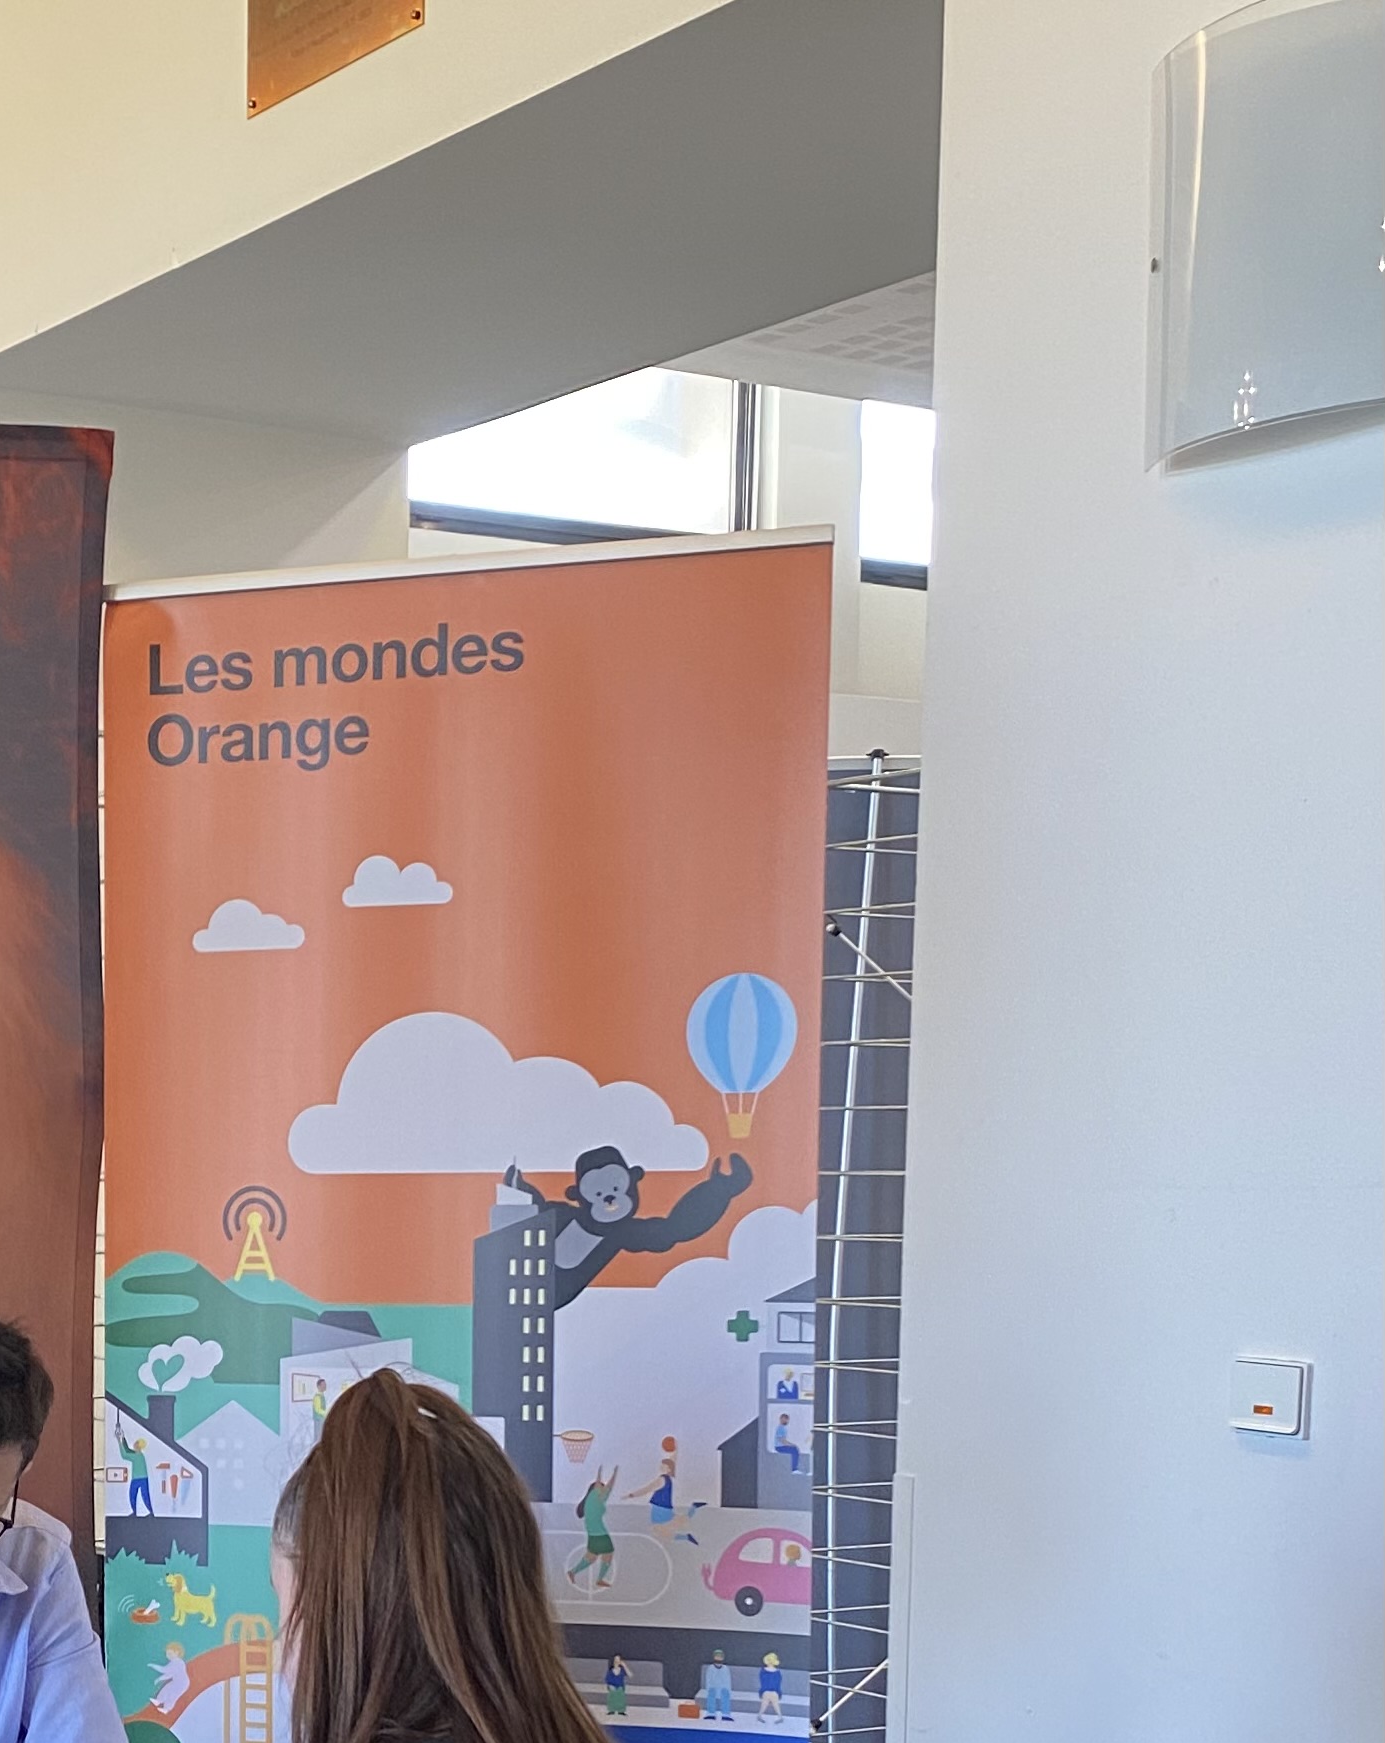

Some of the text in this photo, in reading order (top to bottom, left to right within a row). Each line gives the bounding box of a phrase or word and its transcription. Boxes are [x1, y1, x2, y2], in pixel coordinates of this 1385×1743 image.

[149, 622, 525, 695] Les mondes
[147, 713, 370, 771] Orange
